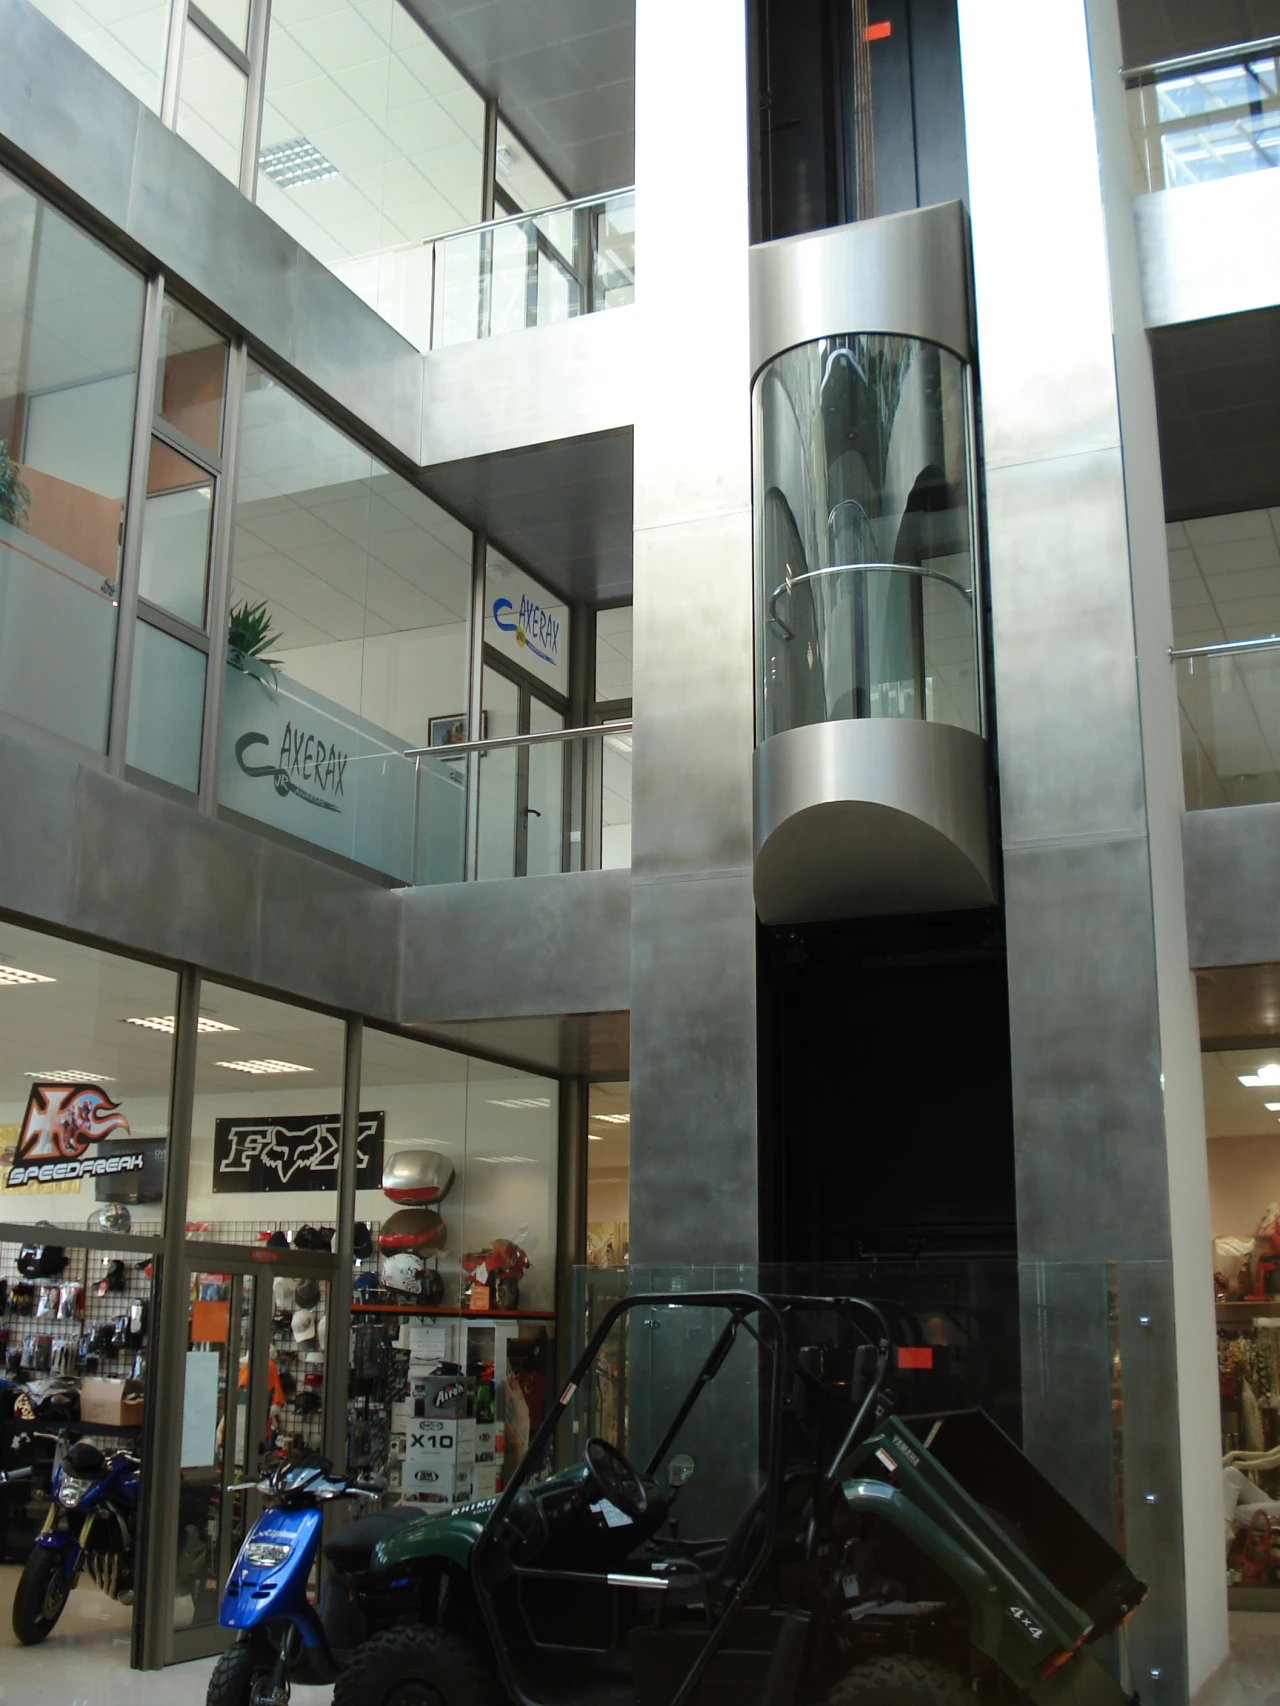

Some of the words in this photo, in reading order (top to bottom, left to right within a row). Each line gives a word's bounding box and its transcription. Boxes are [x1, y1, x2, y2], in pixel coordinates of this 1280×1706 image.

[8, 1155, 144, 1186] SPEEDFREAK
[410, 1434, 453, 1448] X10
[891, 1434, 920, 1467] YAMAHA
[451, 1498, 497, 1516] RHINO
